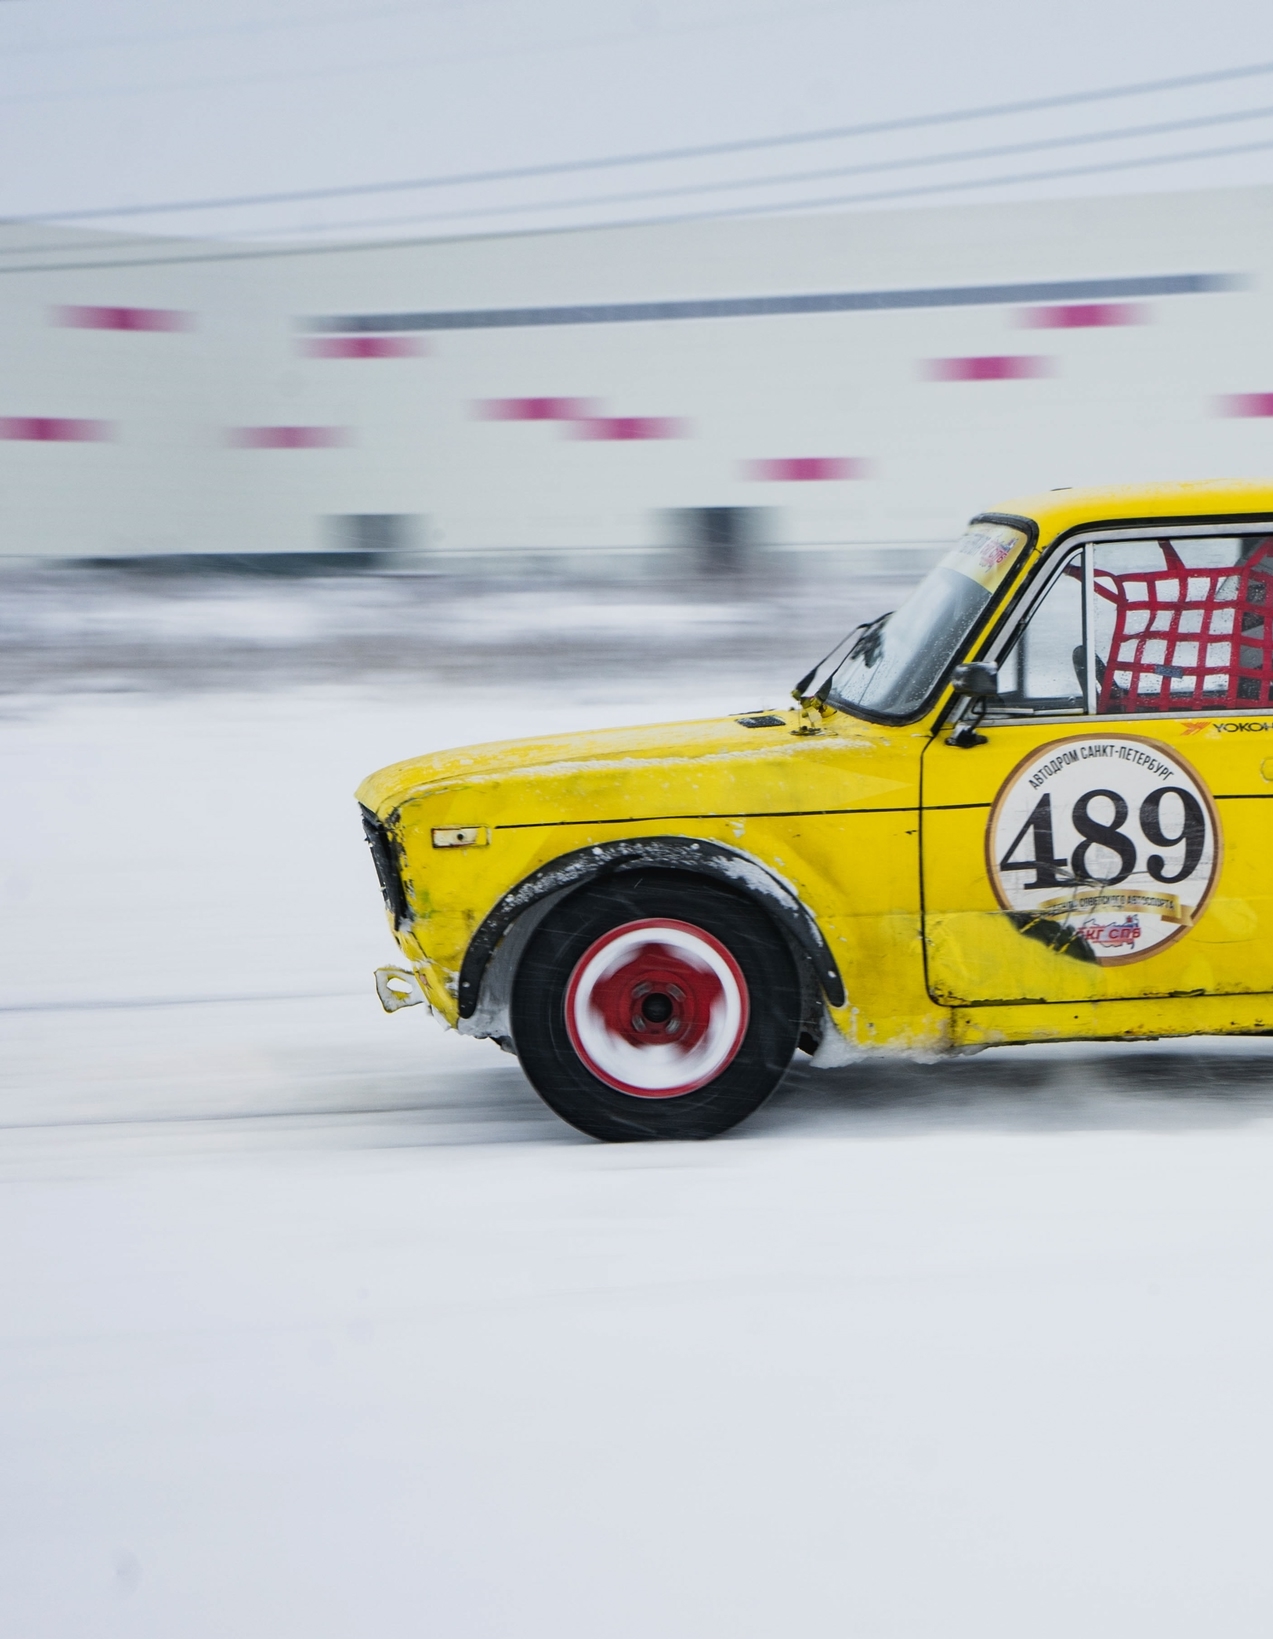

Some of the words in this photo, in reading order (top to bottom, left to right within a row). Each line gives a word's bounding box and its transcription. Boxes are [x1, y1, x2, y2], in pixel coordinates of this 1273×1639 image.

[1028, 748, 1080, 790] АВТОДРОМ
[1080, 744, 1175, 781] САНКТ-ПЕТЕРБУРГ
[1000, 786, 1206, 890] 489
[1108, 927, 1141, 939] СПБ
